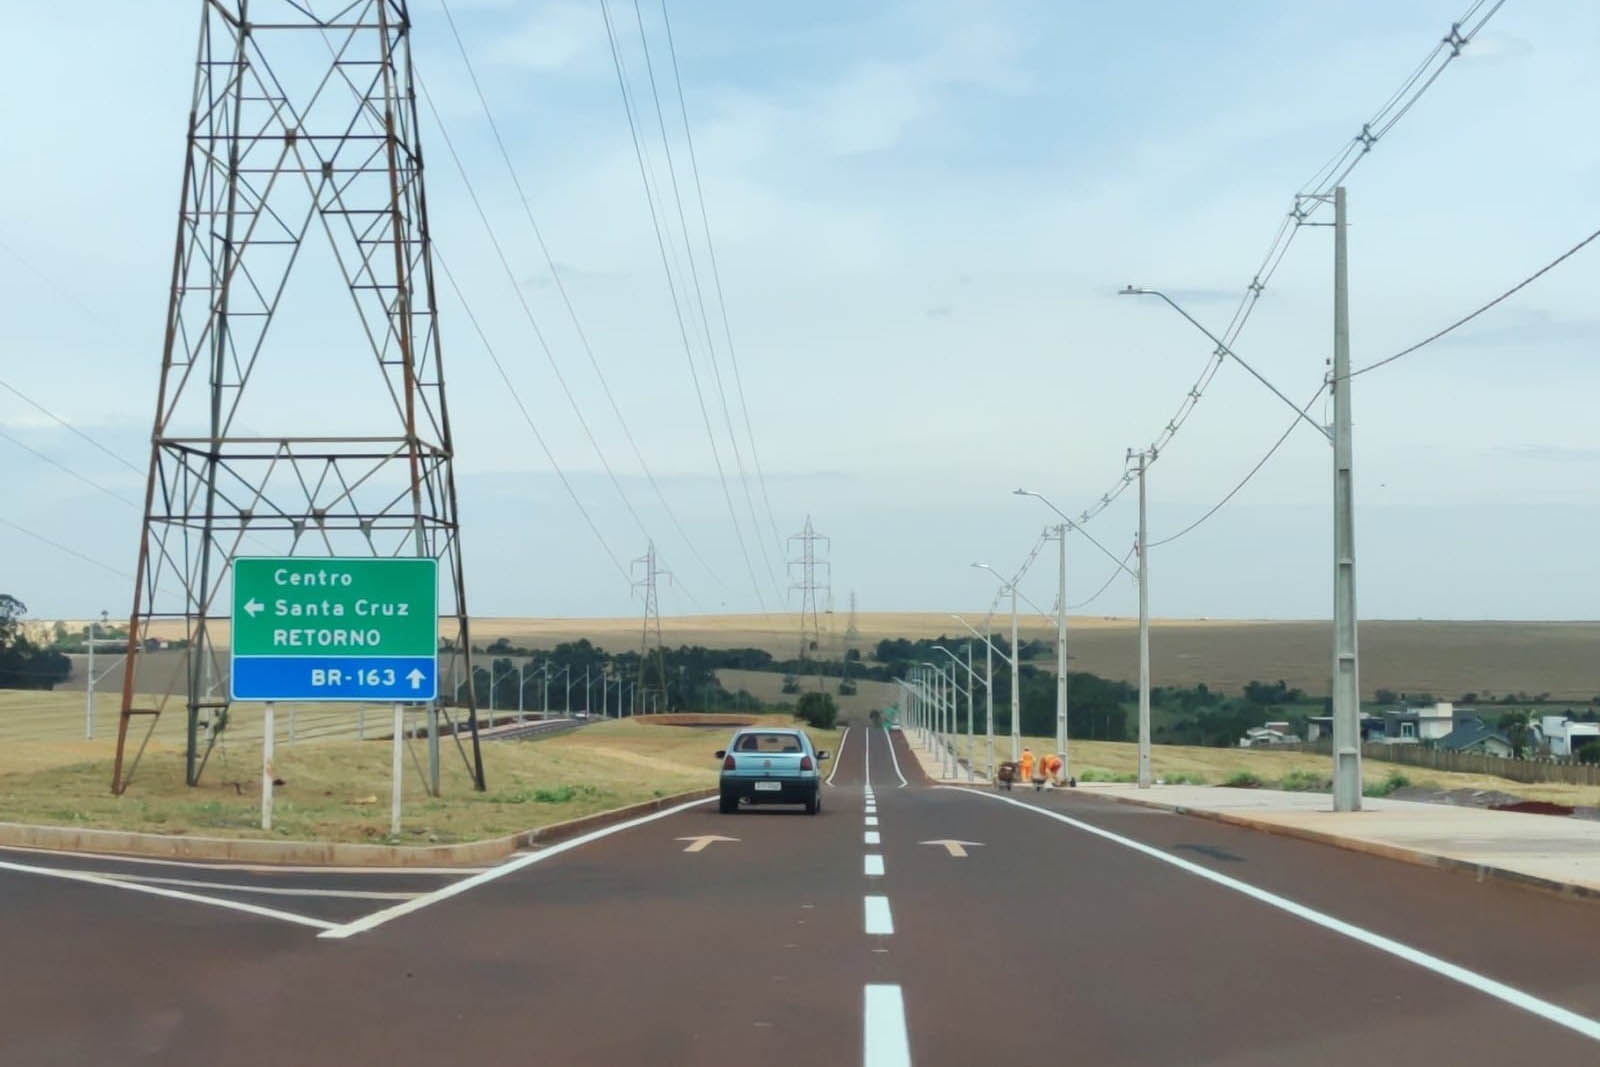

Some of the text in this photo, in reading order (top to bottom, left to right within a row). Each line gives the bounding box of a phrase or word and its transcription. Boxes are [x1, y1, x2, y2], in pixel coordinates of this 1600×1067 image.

[274, 568, 353, 586] Centro
[274, 599, 409, 616] Santa Cruz
[273, 629, 381, 646] RETORNO
[311, 669, 396, 686] BR-163
